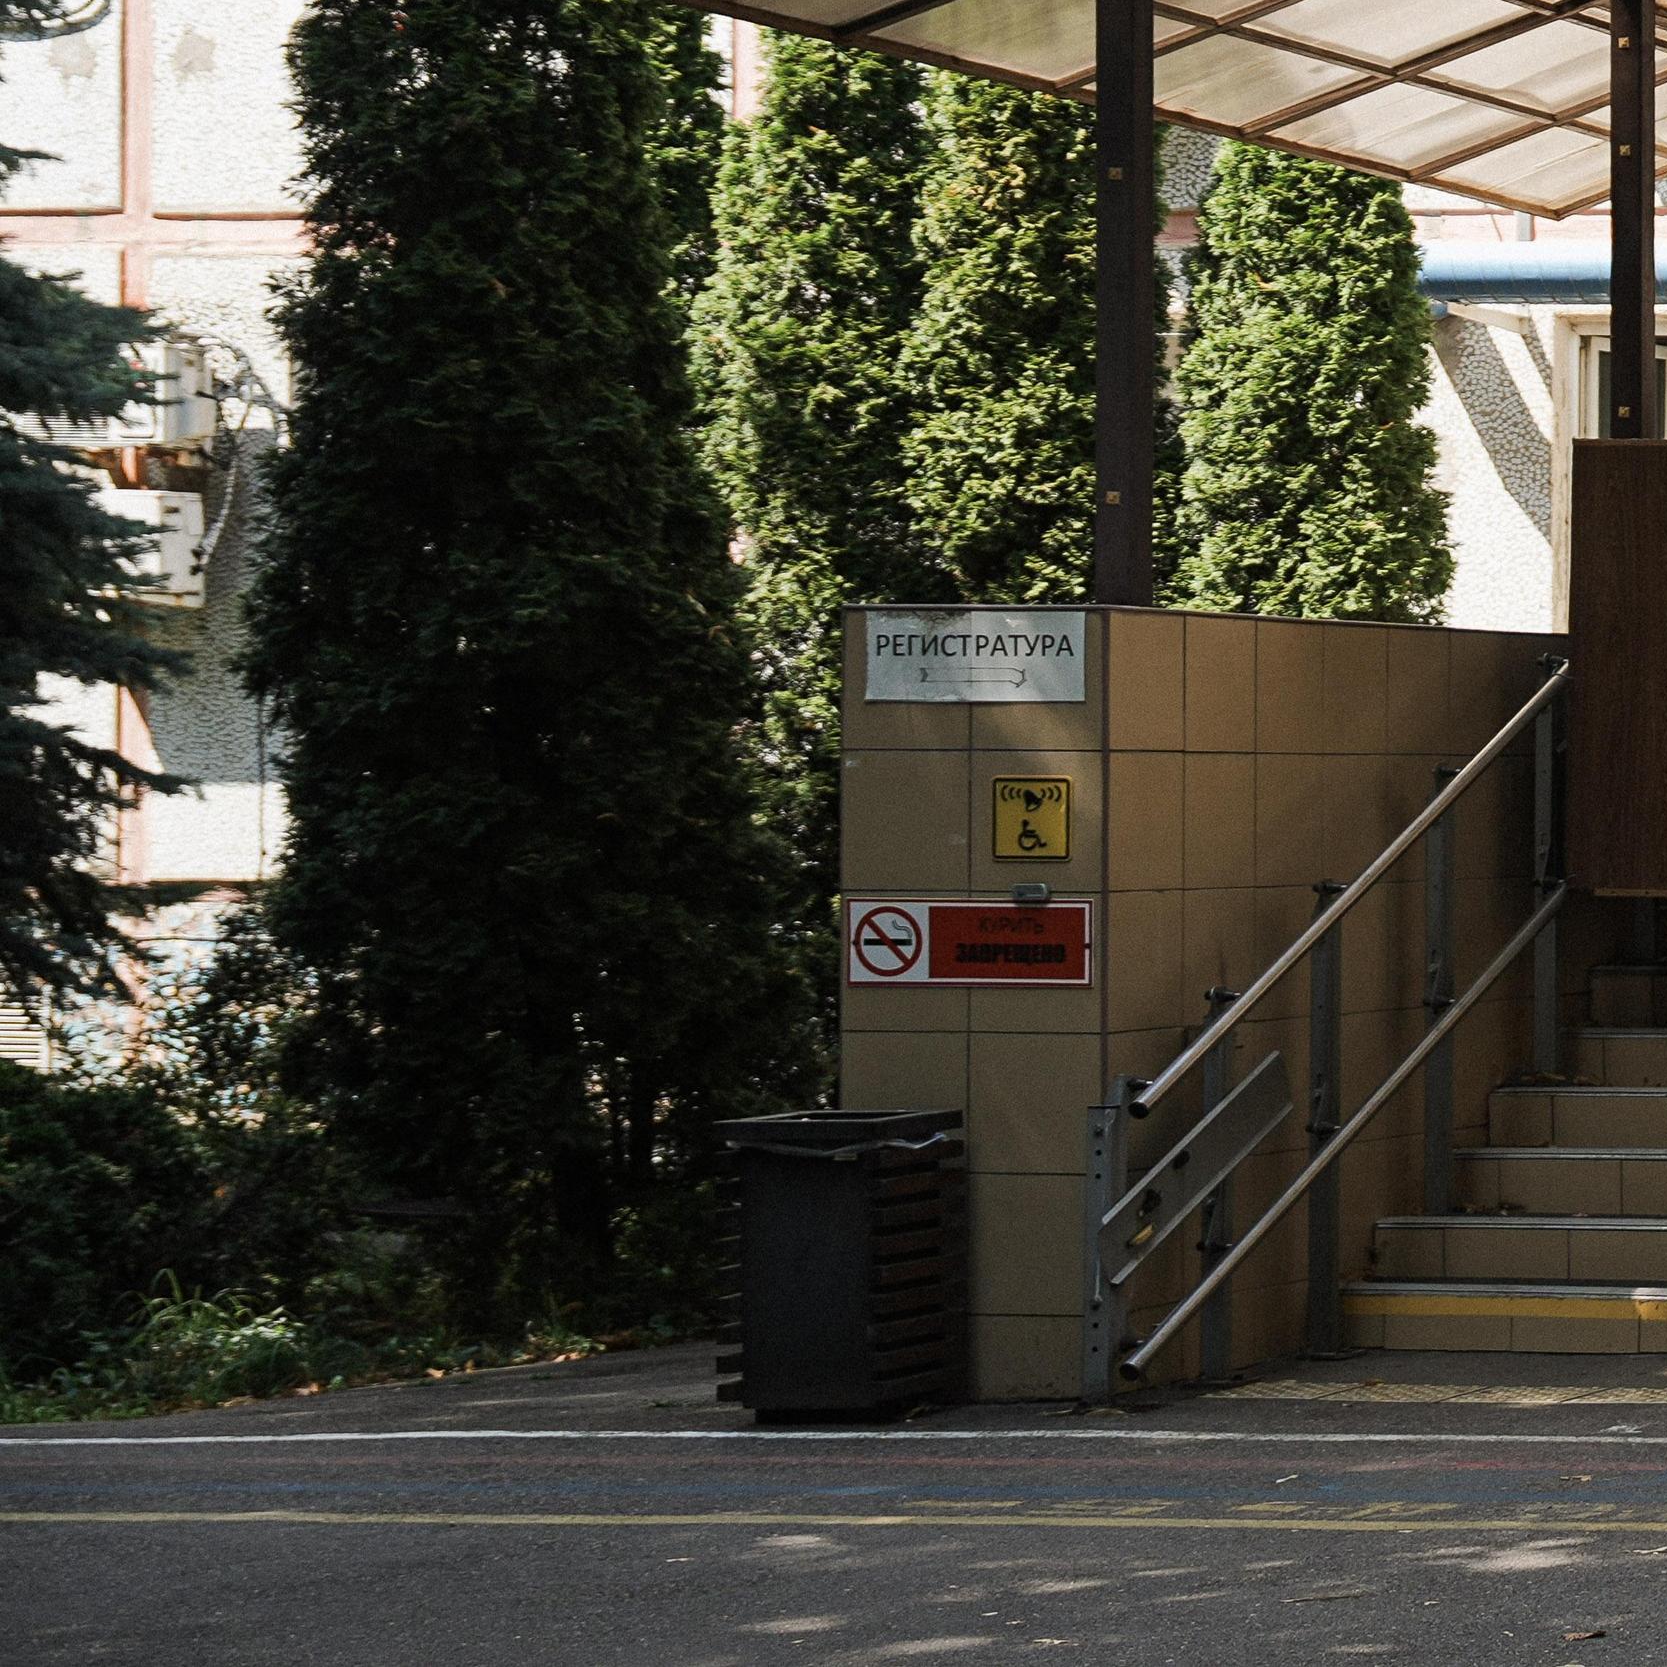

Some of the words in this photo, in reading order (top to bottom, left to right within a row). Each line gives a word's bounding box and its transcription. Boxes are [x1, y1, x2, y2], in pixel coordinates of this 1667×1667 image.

[876, 634, 1074, 657] РЕГИСТРАТУРА
[979, 917, 1044, 933] КУРИТЬ
[955, 943, 1066, 965] ЗАПРЕЩЕНО
